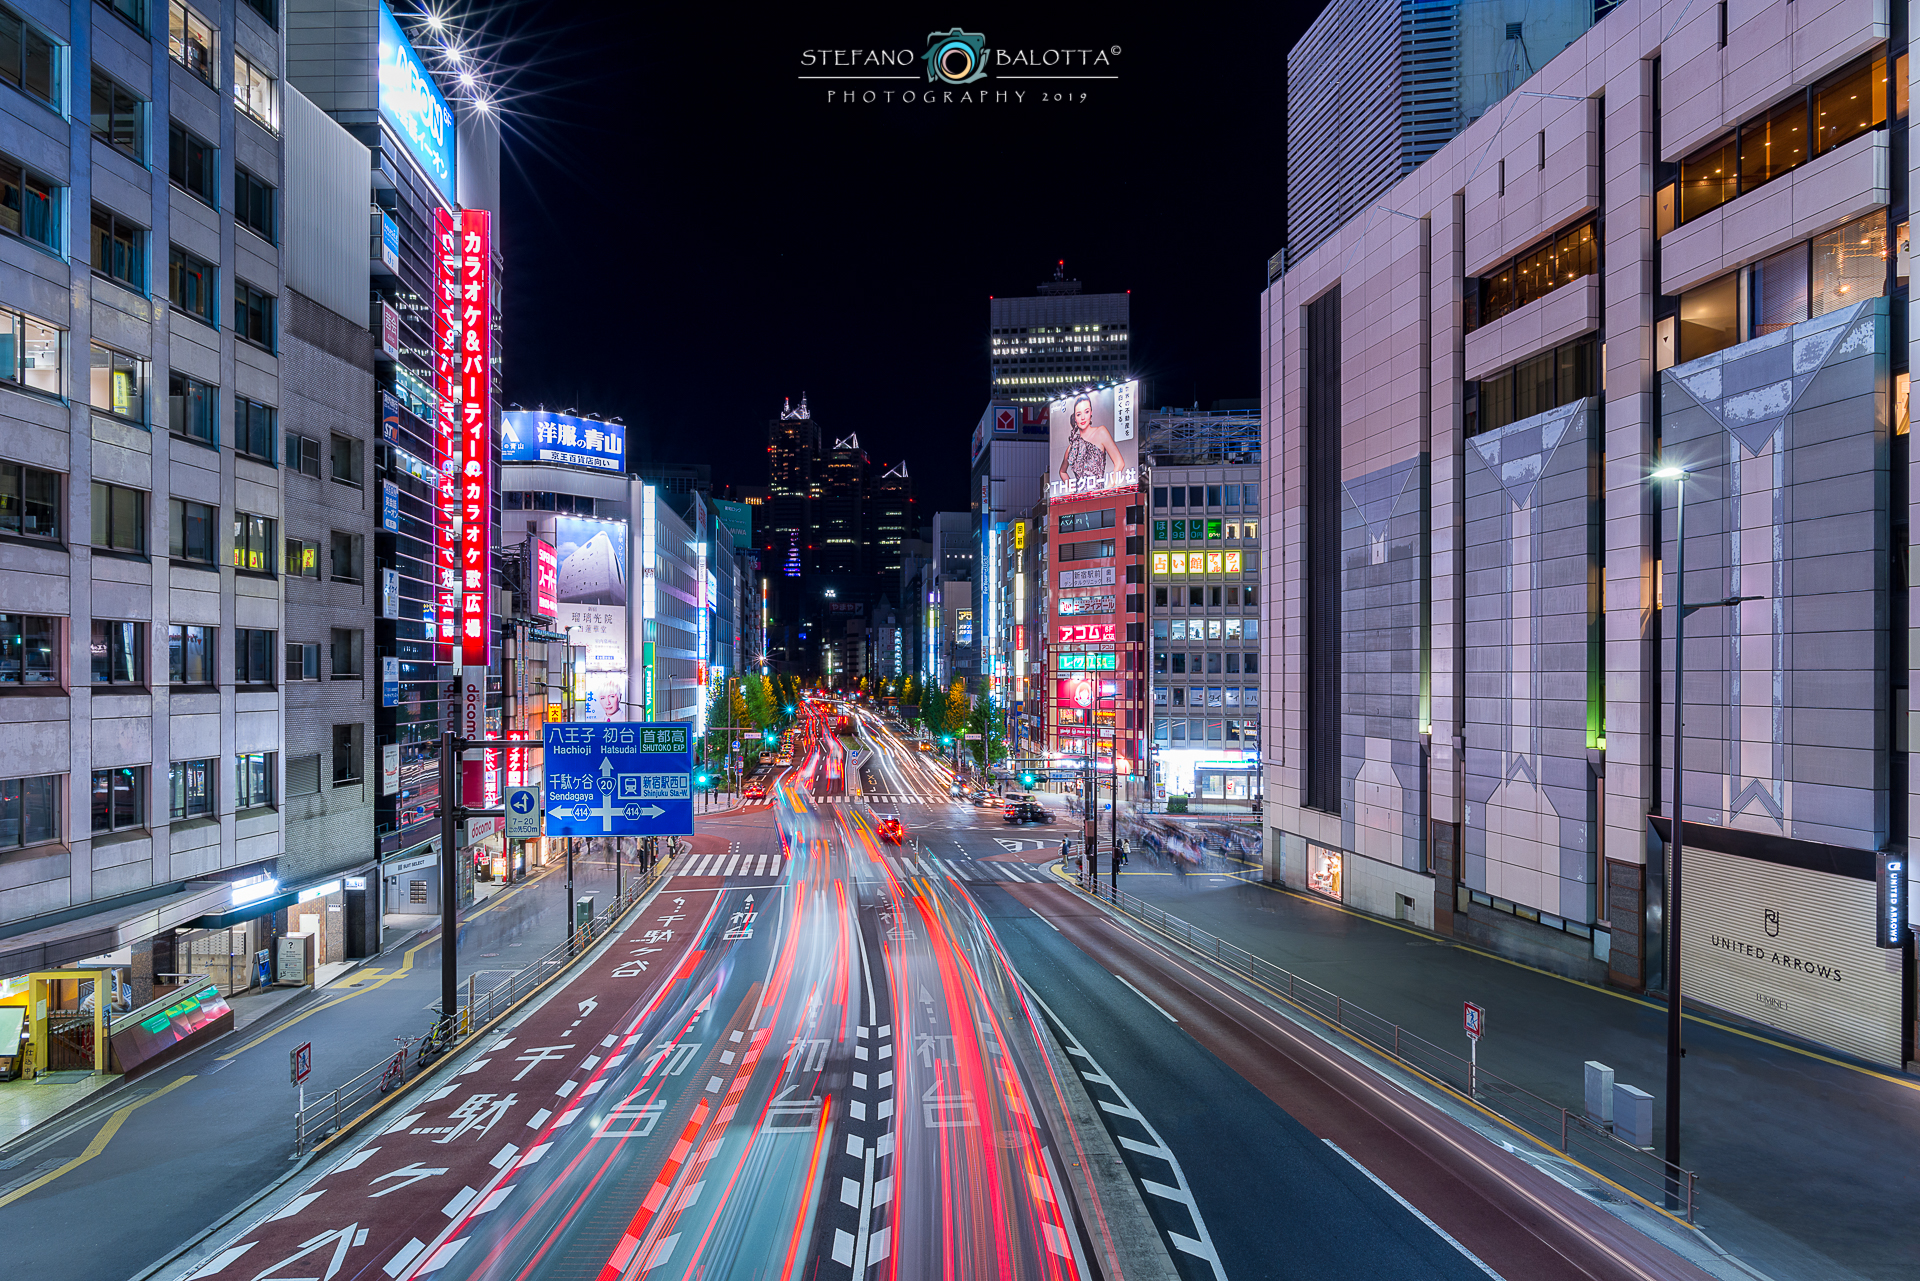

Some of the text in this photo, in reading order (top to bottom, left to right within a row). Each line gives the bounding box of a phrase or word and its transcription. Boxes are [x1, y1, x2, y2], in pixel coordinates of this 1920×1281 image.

[465, 231, 483, 458] カラオケ&パーティー
[537, 421, 622, 455] 洋服の青山
[551, 451, 611, 466] 京王百貨店向い
[730, 527, 747, 535] MIWA
[1156, 520, 1201, 530] ほぐし
[465, 483, 482, 637] カラオケ歌広場
[1154, 557, 1203, 570] 占い館
[1074, 569, 1101, 580] 新宿駅前
[1074, 601, 1115, 611] エーアイアール
[571, 612, 613, 624] 瑠璃光院
[1062, 626, 1100, 641] アコム
[549, 727, 686, 744] 八王子 初台 首都高
[553, 744, 685, 756] Hachioji Hatsudai SHUTOKO EXP
[600, 781, 613, 790] 20
[643, 775, 688, 790] 新宿駅西口
[549, 791, 594, 802] Sendagaya
[643, 789, 669, 798] Shinjuku
[625, 809, 640, 817] 414
[471, 820, 492, 838] docomo
[1889, 873, 1898, 905] UNITED
[722, 911, 759, 941] 初台
[1889, 906, 1898, 943] ARROWS
[1711, 934, 1843, 983] UNITED ARROWS
[760, 1036, 831, 1134] 初台
[915, 1033, 981, 1128] 初台
[590, 1040, 702, 1138] 初台
